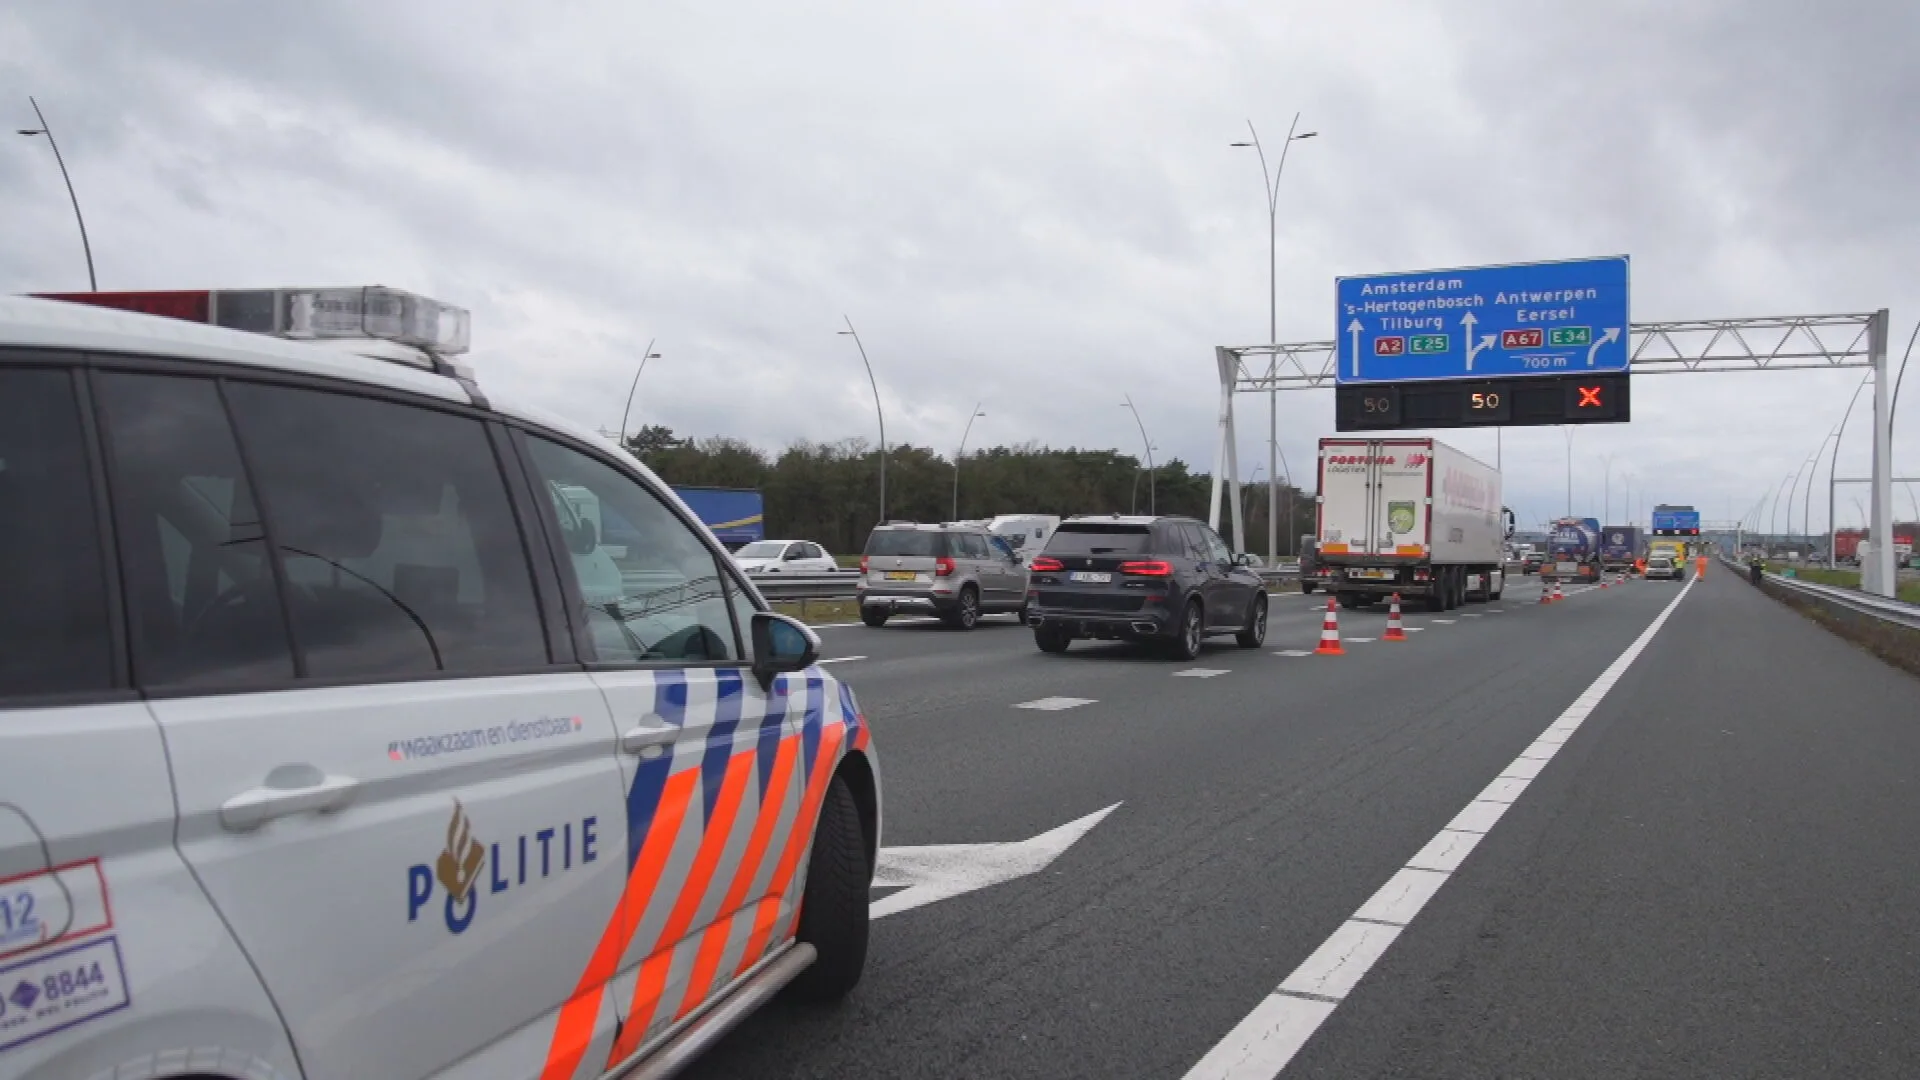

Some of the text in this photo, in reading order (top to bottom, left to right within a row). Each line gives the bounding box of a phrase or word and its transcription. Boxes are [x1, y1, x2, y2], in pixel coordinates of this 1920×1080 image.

[1360, 278, 1463, 296] Amsterdam
[1344, 294, 1484, 315] 's-Hertogenbosch
[1494, 288, 1597, 306] Antwerpen
[1380, 315, 1443, 331] Tilburg
[1516, 307, 1575, 323] Eersel
[1378, 340, 1401, 353] A2
[1412, 337, 1445, 351] E25
[1505, 333, 1539, 345] A67
[1523, 357, 1567, 369] 700 m
[1364, 397, 1389, 413] 50
[1471, 393, 1499, 409] 50
[488, 728, 507, 746] en
[407, 816, 598, 935] POLITIE
[43, 962, 104, 1000] 8844
